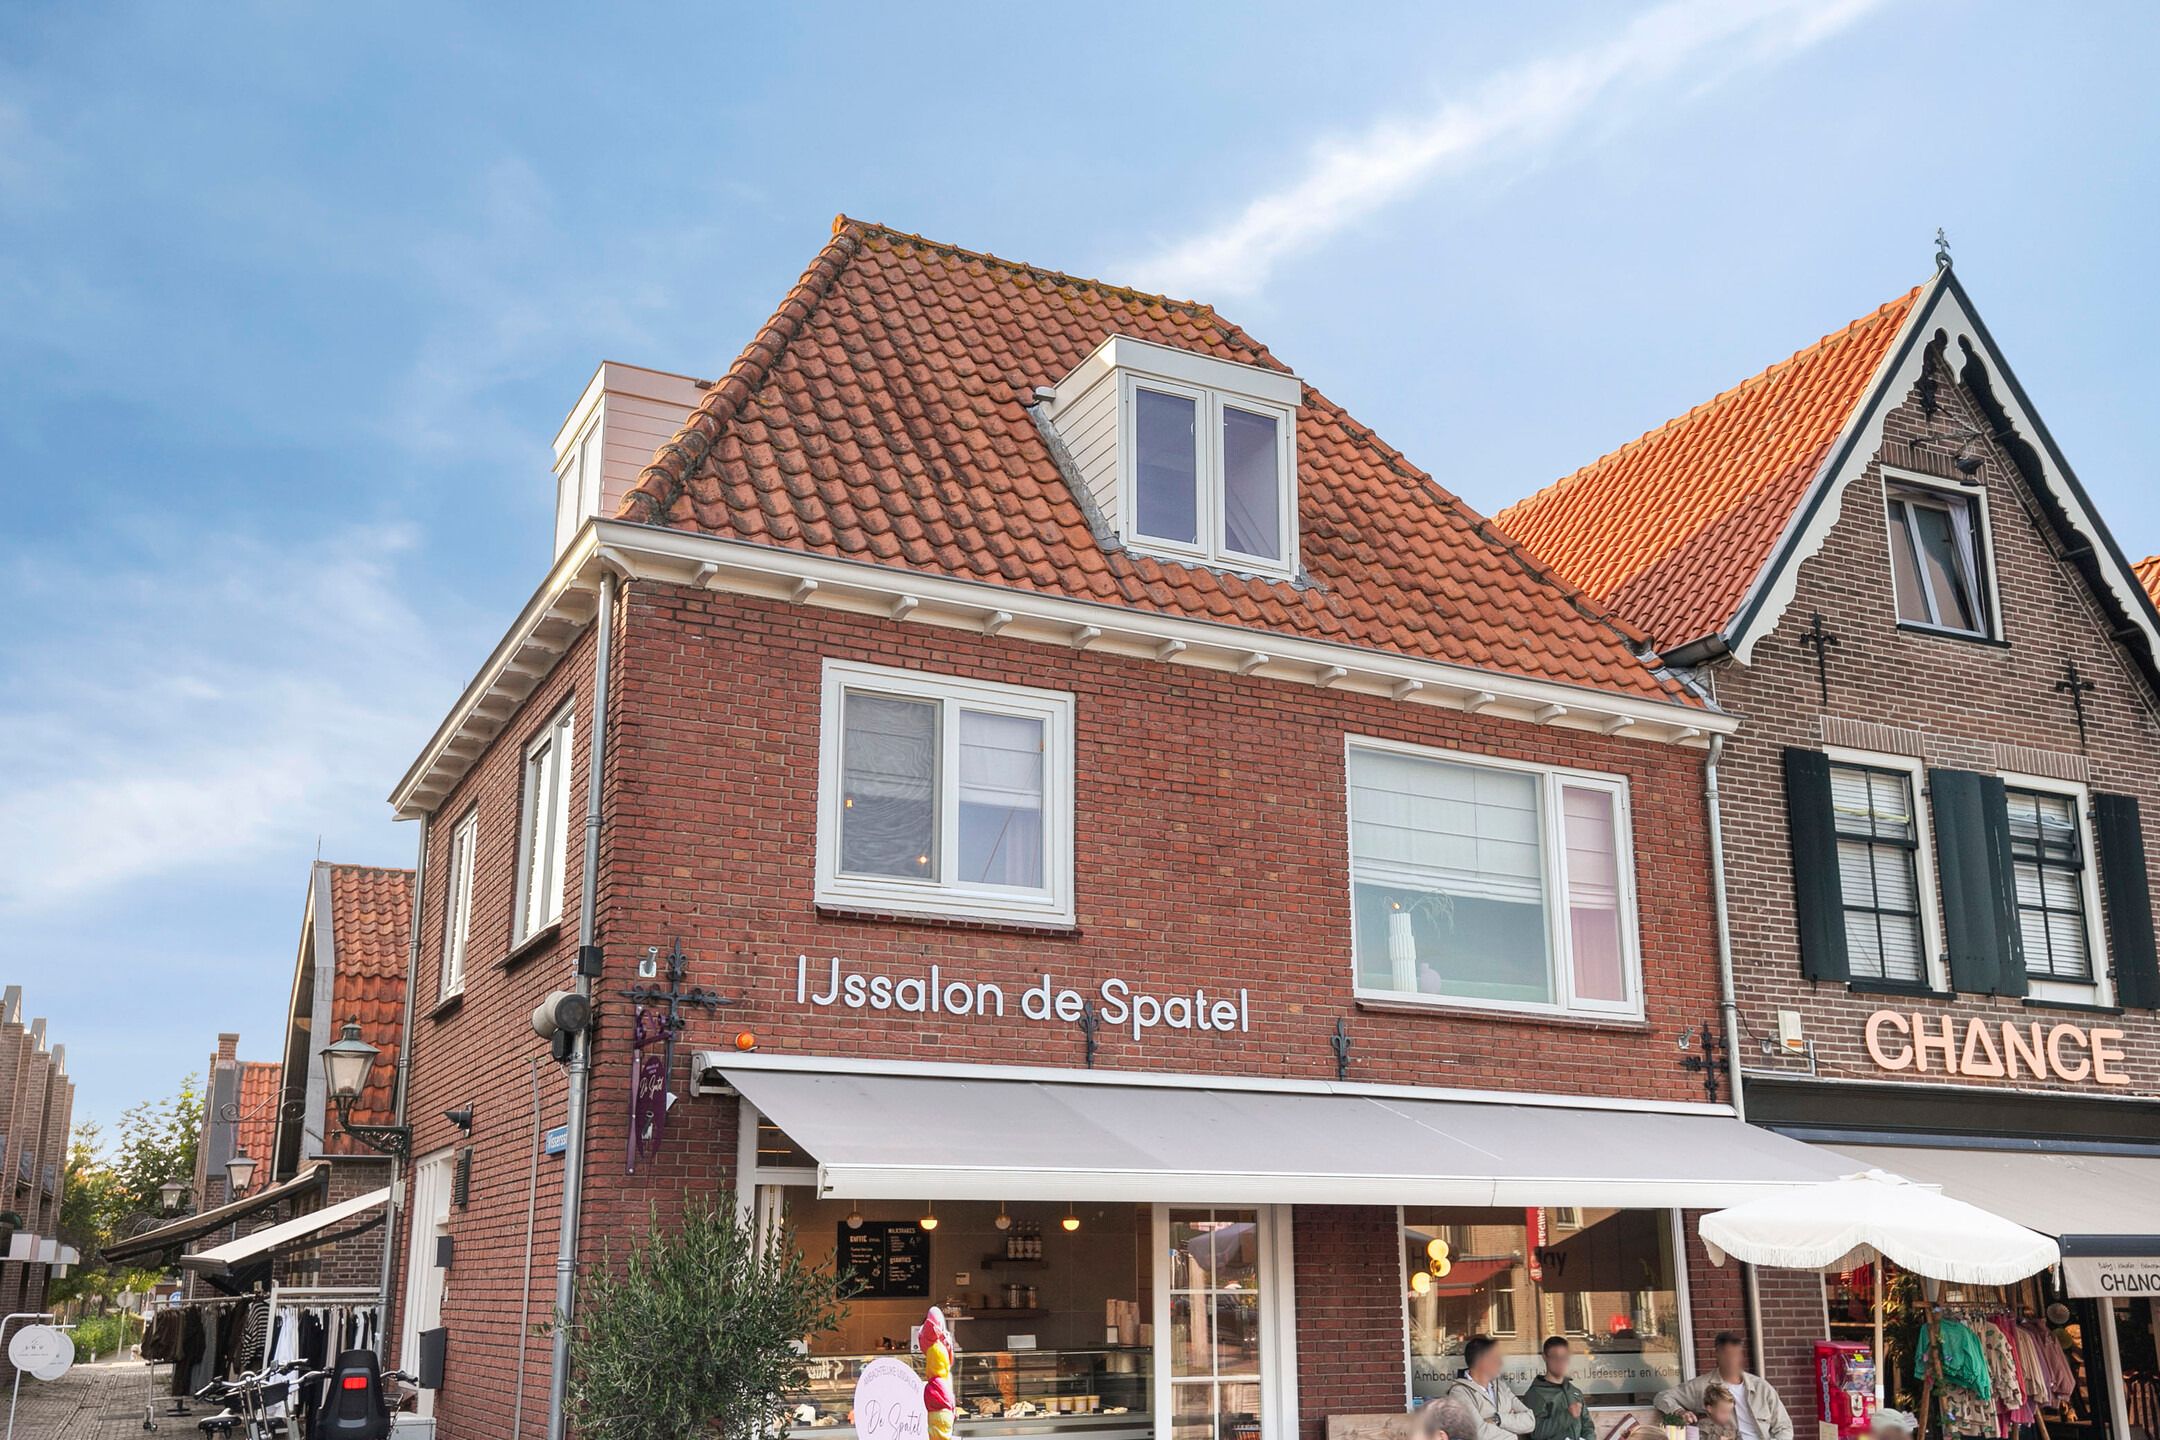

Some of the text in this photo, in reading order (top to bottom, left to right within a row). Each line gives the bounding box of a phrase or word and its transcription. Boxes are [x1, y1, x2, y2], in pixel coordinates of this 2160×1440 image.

[798, 954, 1249, 1042] IJssalon de Spatel
[1639, 1368, 1652, 1378] en
[865, 1399, 884, 1435] De
